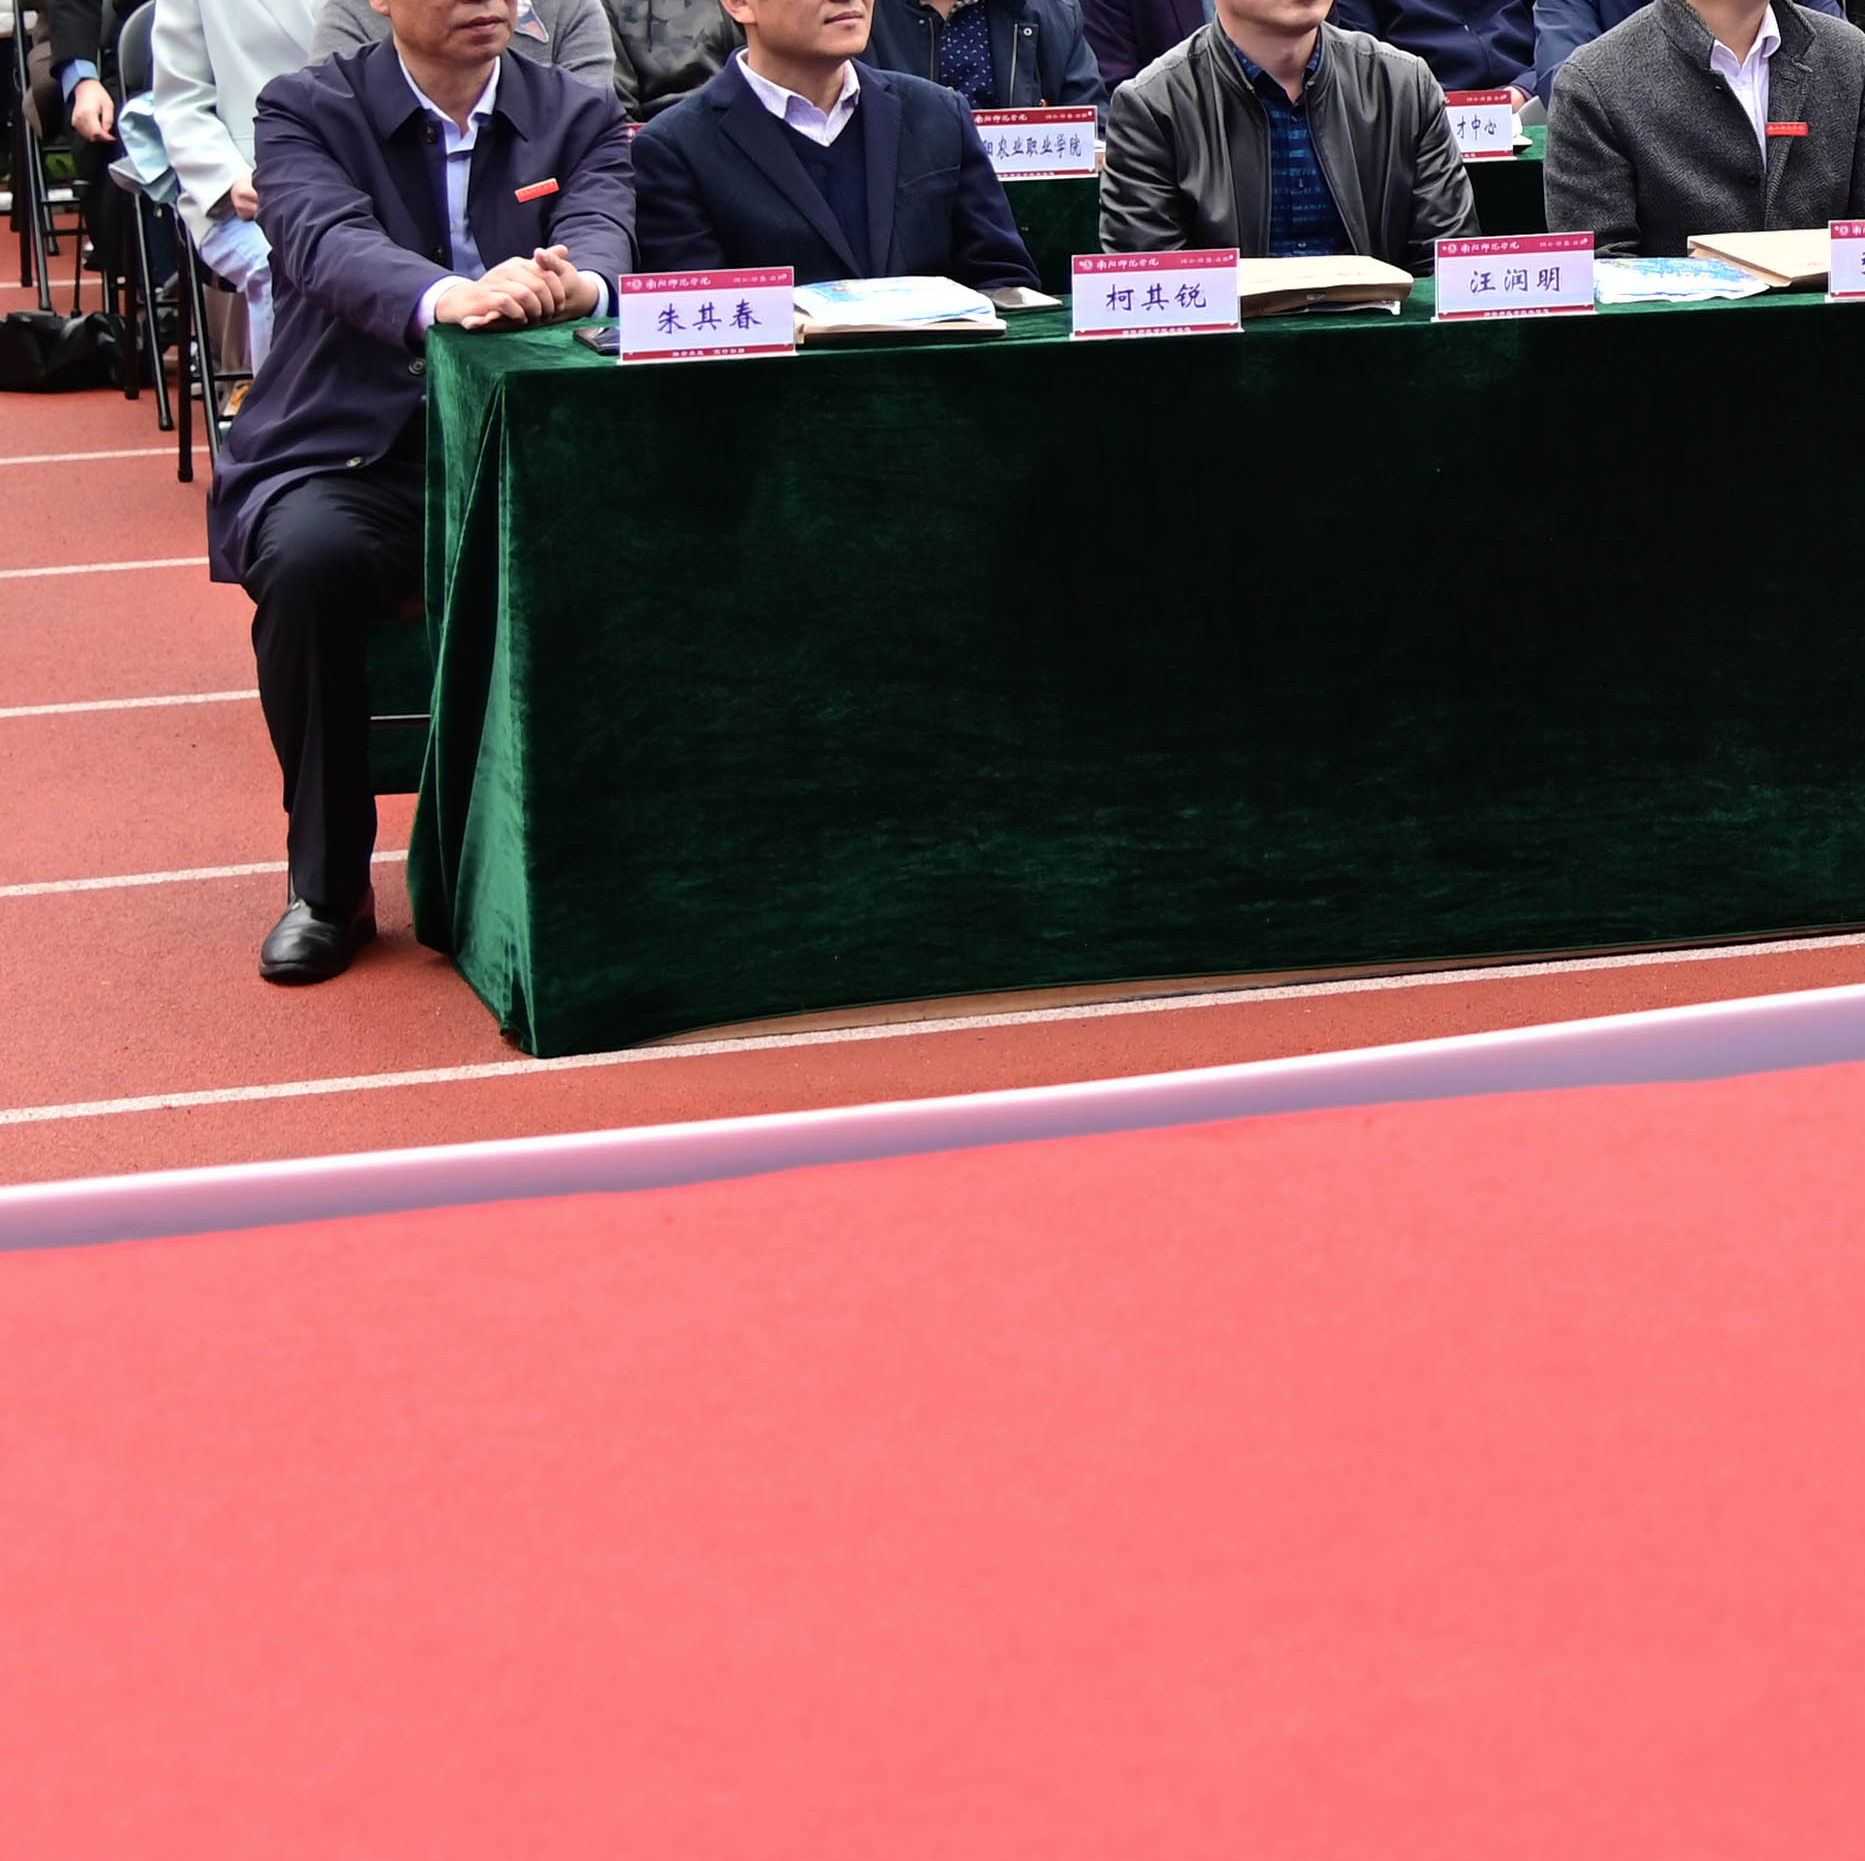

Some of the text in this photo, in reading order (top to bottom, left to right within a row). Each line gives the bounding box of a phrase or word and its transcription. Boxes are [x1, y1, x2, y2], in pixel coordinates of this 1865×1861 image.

[1470, 266, 1561, 293] 汪润明
[1105, 282, 1207, 311] 柯其锐
[657, 298, 762, 334] 朱其春
